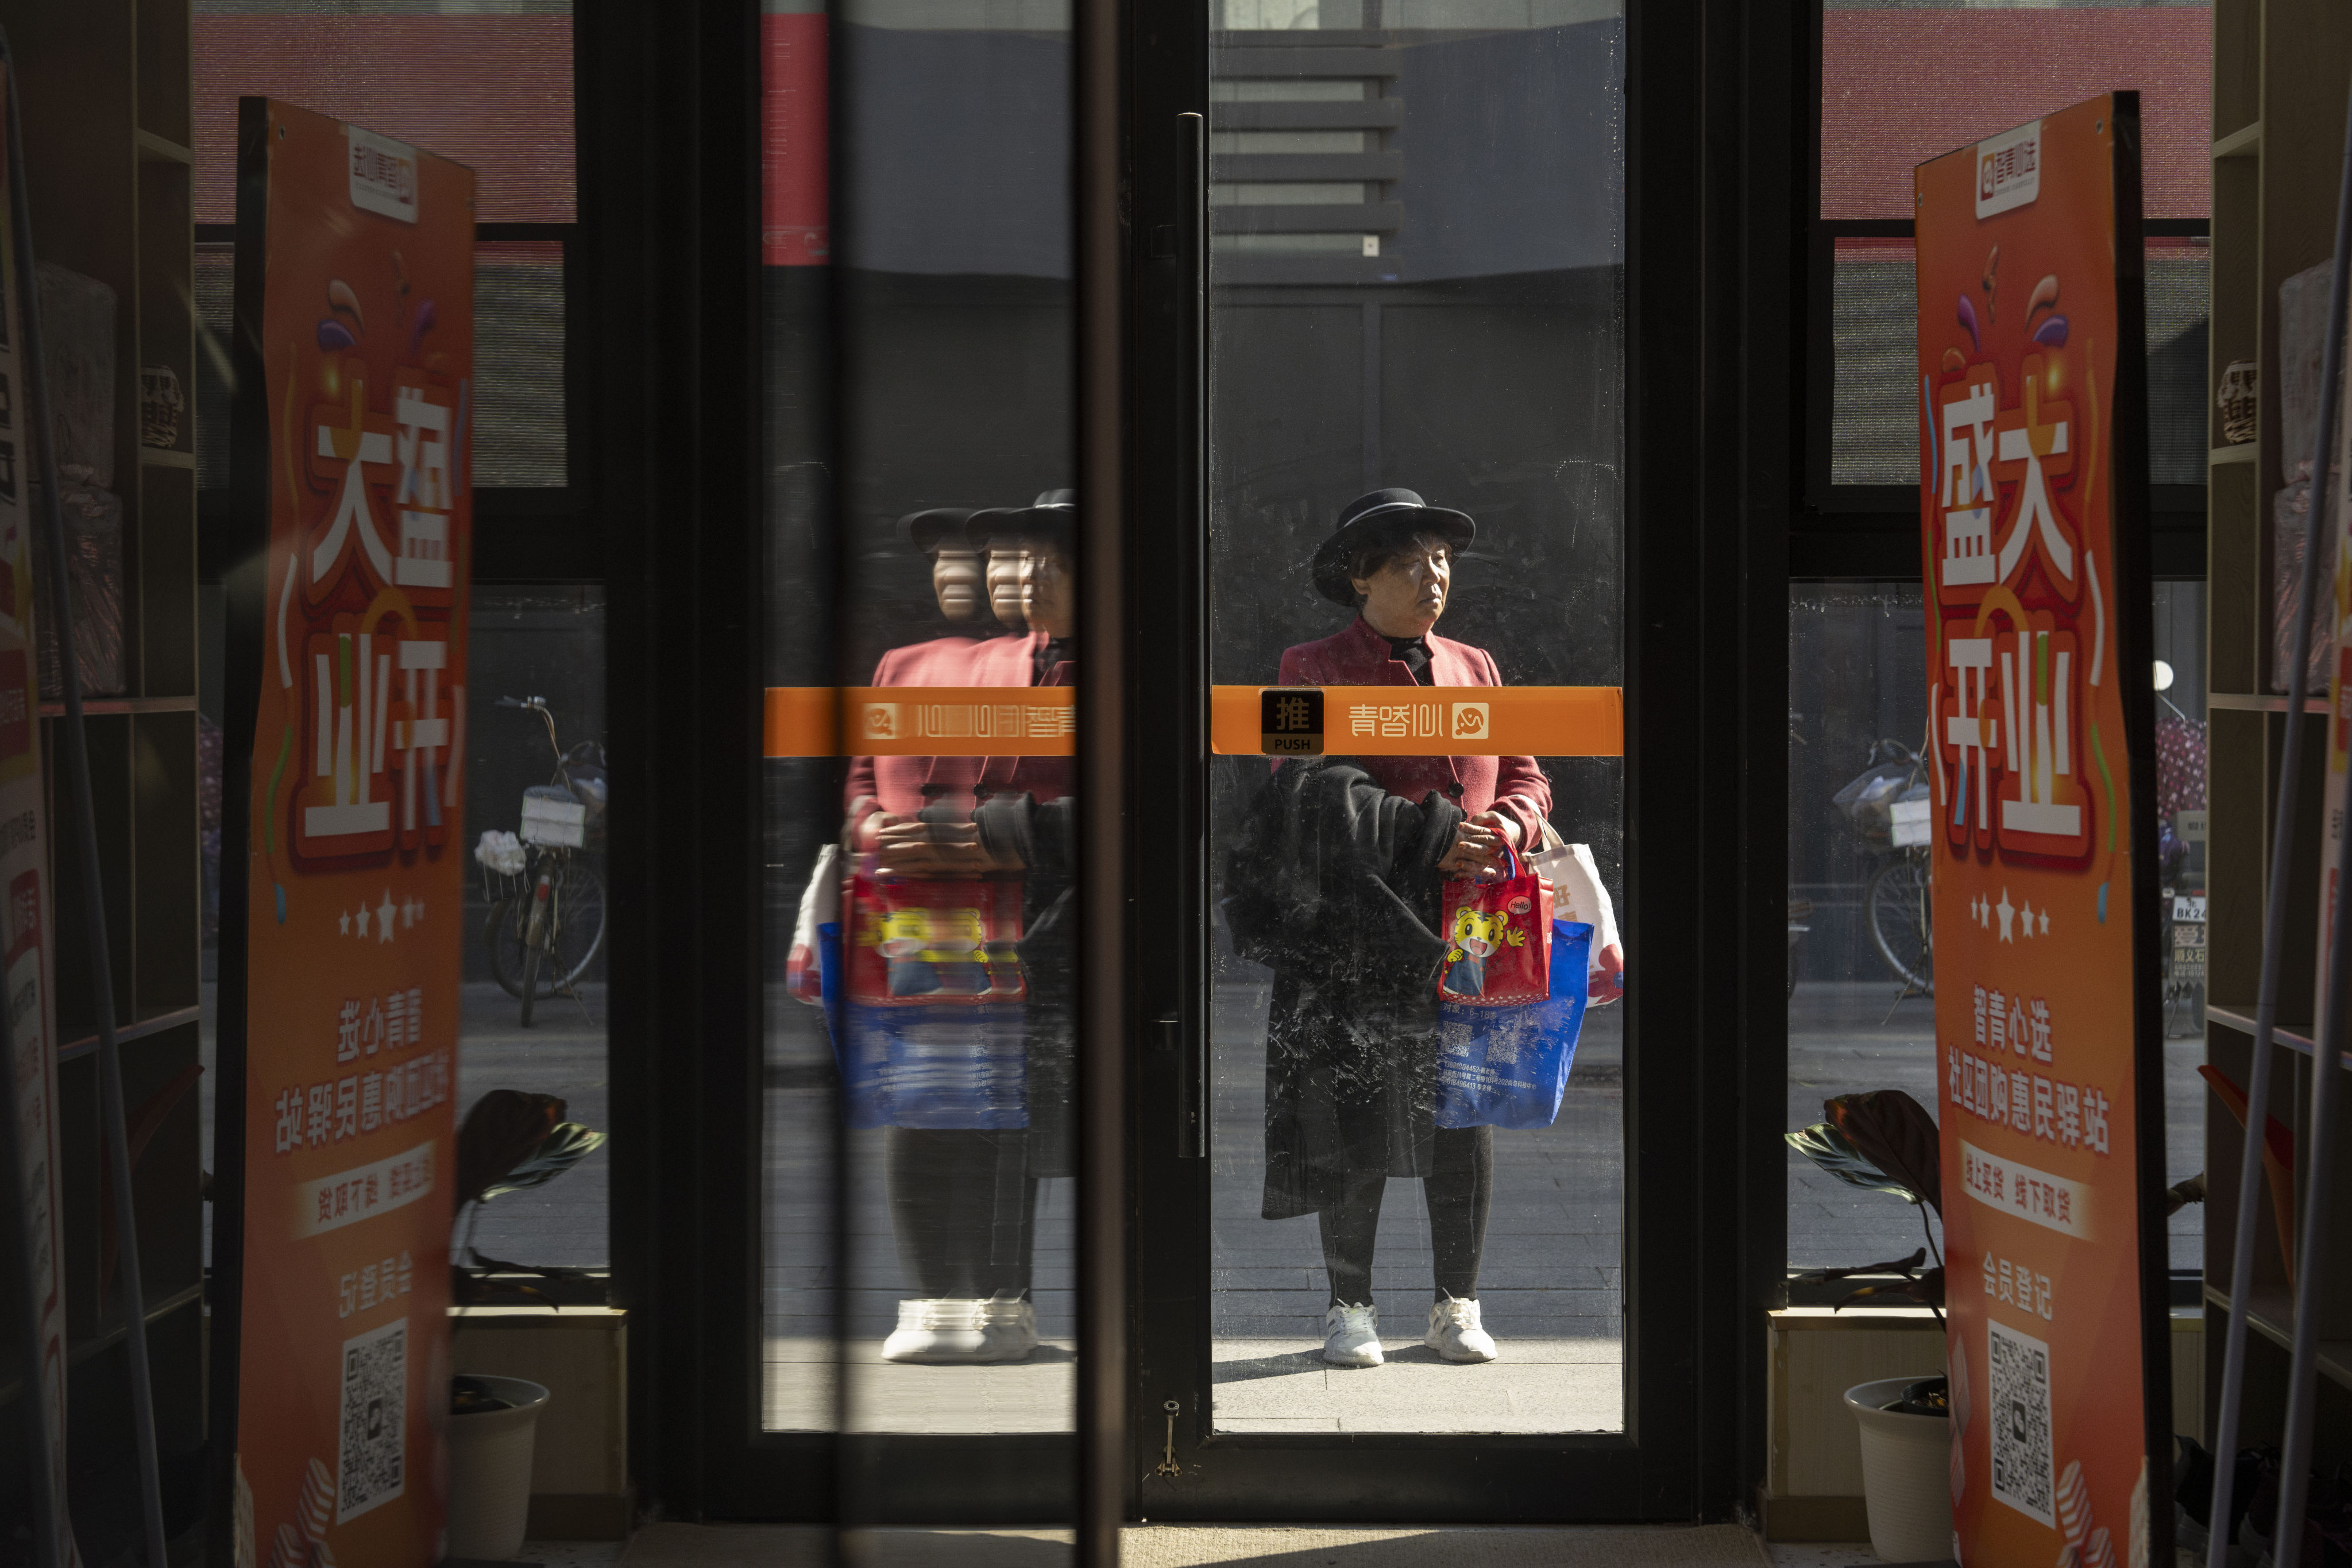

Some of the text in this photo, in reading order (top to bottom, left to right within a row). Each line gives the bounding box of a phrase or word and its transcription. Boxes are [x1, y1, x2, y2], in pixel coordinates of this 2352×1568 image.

[1942, 381, 2073, 586] 盛大
[1275, 739, 1310, 750] PUSH
[1276, 696, 1310, 731] 推
[1947, 630, 2082, 837] 开业
[1510, 901, 1531, 911] Hello!
[1973, 983, 2053, 1064] 智青心选
[1948, 1045, 2110, 1155] 社区团购惠民驿站
[1965, 1152, 2072, 1225] 线上买货 线下取货
[1982, 1250, 2054, 1322] 会员登记
